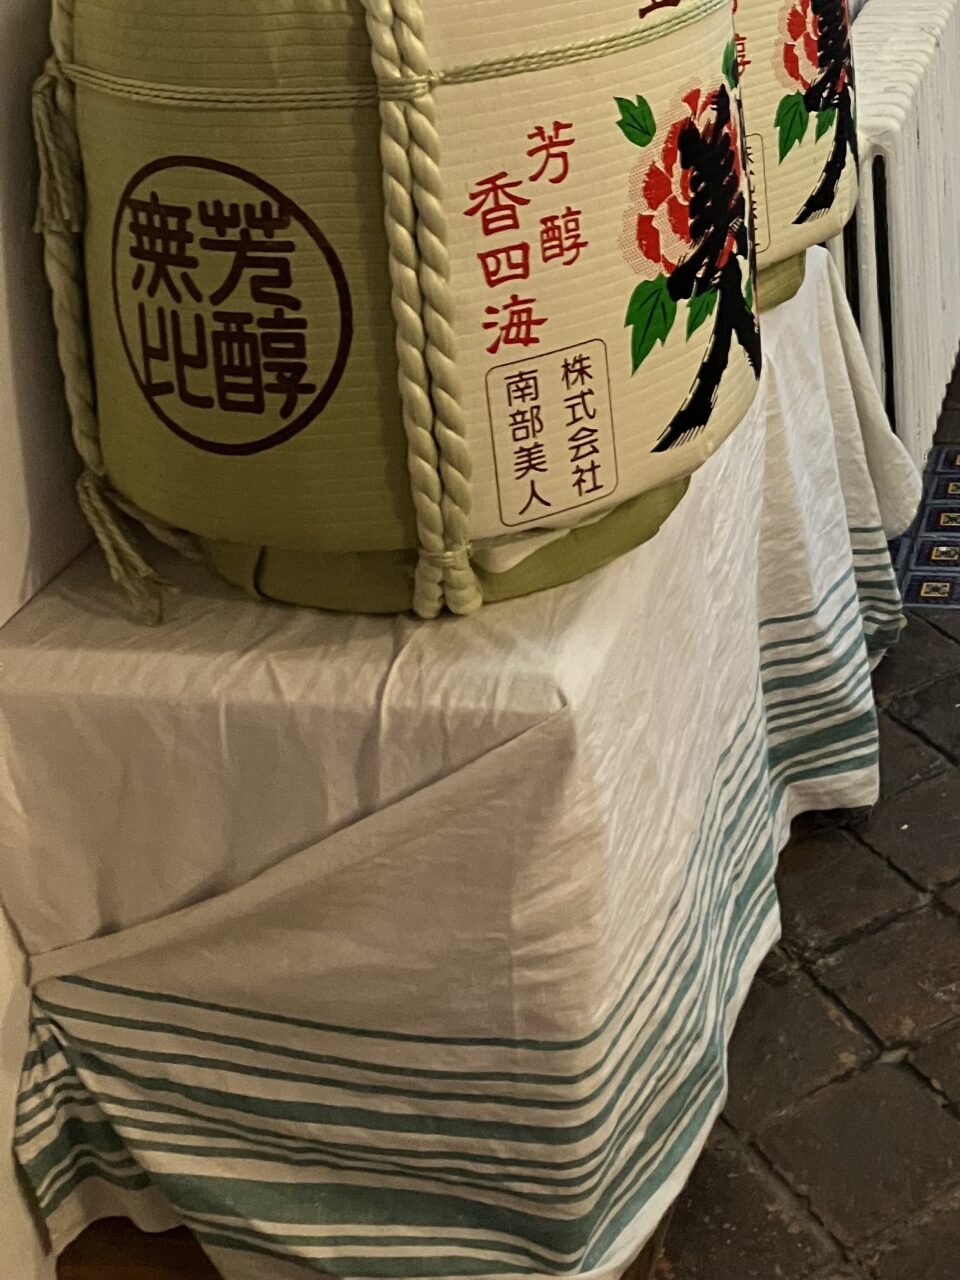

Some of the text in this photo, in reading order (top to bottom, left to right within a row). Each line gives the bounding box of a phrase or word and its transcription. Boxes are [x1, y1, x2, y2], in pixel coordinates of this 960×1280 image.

[463, 171, 549, 356] 香四海
[525, 119, 590, 267] 芳醇
[503, 369, 553, 516] 南部美人
[561, 352, 605, 499] 株式会社
